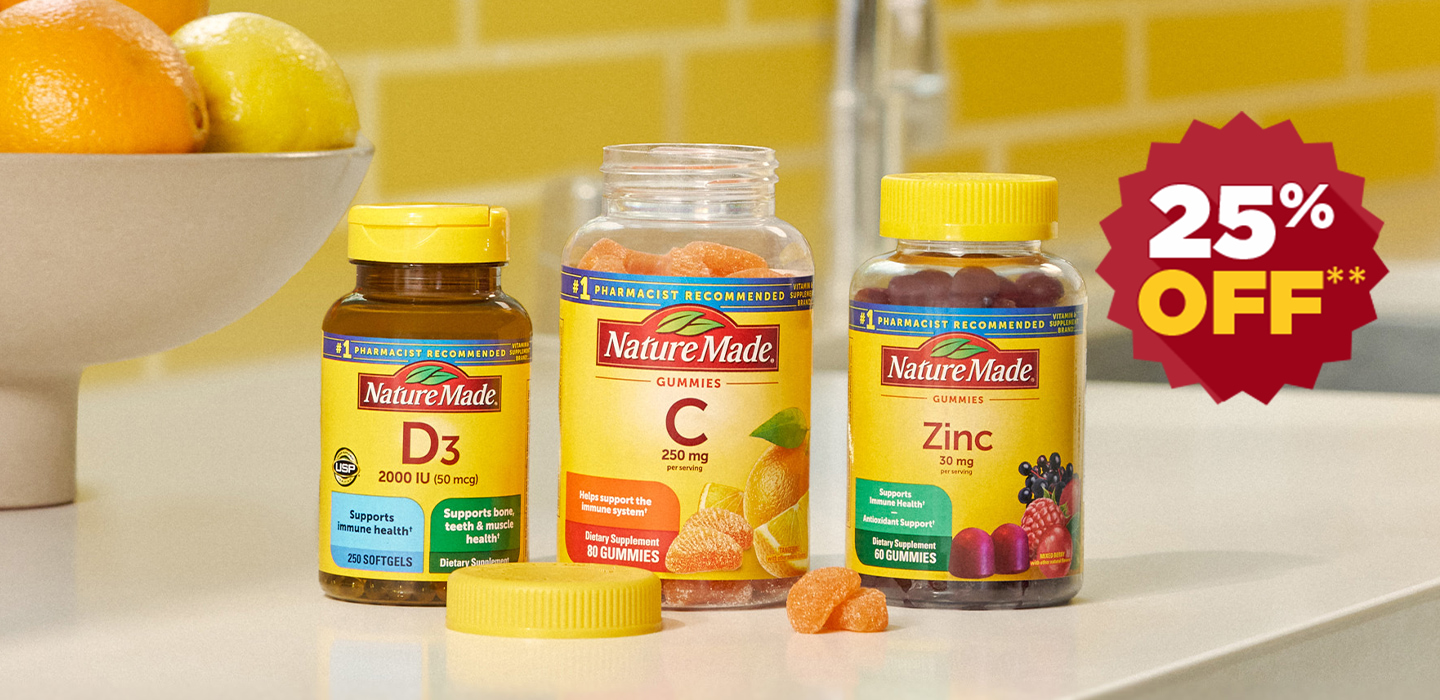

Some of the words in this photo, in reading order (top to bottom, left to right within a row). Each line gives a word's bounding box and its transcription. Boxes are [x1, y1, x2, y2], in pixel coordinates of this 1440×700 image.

[572, 276, 591, 300] #1
[594, 284, 678, 300] PHARMACIST
[685, 291, 785, 301] RECOMMENDED
[859, 309, 875, 330] #1
[878, 317, 948, 329] PHARMACIST
[953, 320, 1045, 330] RECOMMENDED
[336, 339, 352, 359] #1
[354, 346, 422, 358] PHARMACIST
[427, 349, 506, 358] RECOMMENDED
[604, 330, 698, 363] Nature
[697, 335, 773, 363] Made
[887, 355, 966, 382] Nature
[966, 357, 1033, 382] Made
[656, 376, 722, 389] GUMMIES
[363, 381, 438, 406] Nature
[438, 383, 496, 406] Made
[932, 395, 984, 405] GUMMIES
[665, 397, 708, 447] C
[922, 421, 993, 451] Zinc
[402, 421, 460, 466] D3
[661, 449, 685, 461] 250
[688, 452, 709, 464] mg
[939, 456, 953, 466] 30
[956, 457, 974, 468] mg
[335, 462, 356, 474] USP
[678, 464, 703, 473] serving
[951, 468, 973, 476] serving
[378, 471, 412, 484] 2000
[416, 472, 430, 484] IU
[434, 474, 451, 486] (50
[453, 474, 479, 487] mcg)
[579, 490, 599, 502] Helps
[600, 494, 634, 506] support
[635, 496, 652, 506] the
[879, 488, 912, 499] Supports
[581, 502, 611, 514] immune
[869, 497, 896, 507] Immune
[349, 509, 394, 523] Supports
[443, 507, 492, 520] Supports
[493, 506, 515, 517] bone,
[863, 514, 899, 526] Antioxidant
[337, 521, 372, 533] immune
[445, 521, 475, 531] teeth
[476, 521, 484, 531] &
[485, 519, 514, 530] muscle
[585, 530, 610, 545] Dietary
[610, 533, 660, 547] Supplement
[872, 536, 893, 549] Dietary
[894, 539, 936, 551] Supplement
[347, 553, 362, 564] 250
[363, 554, 413, 567] SOFTGELS
[587, 544, 598, 558] 80
[600, 545, 660, 563] GUMMIES
[874, 548, 885, 560] 60
[886, 549, 937, 564] GUMMIES
[440, 558, 470, 568] Dietary
